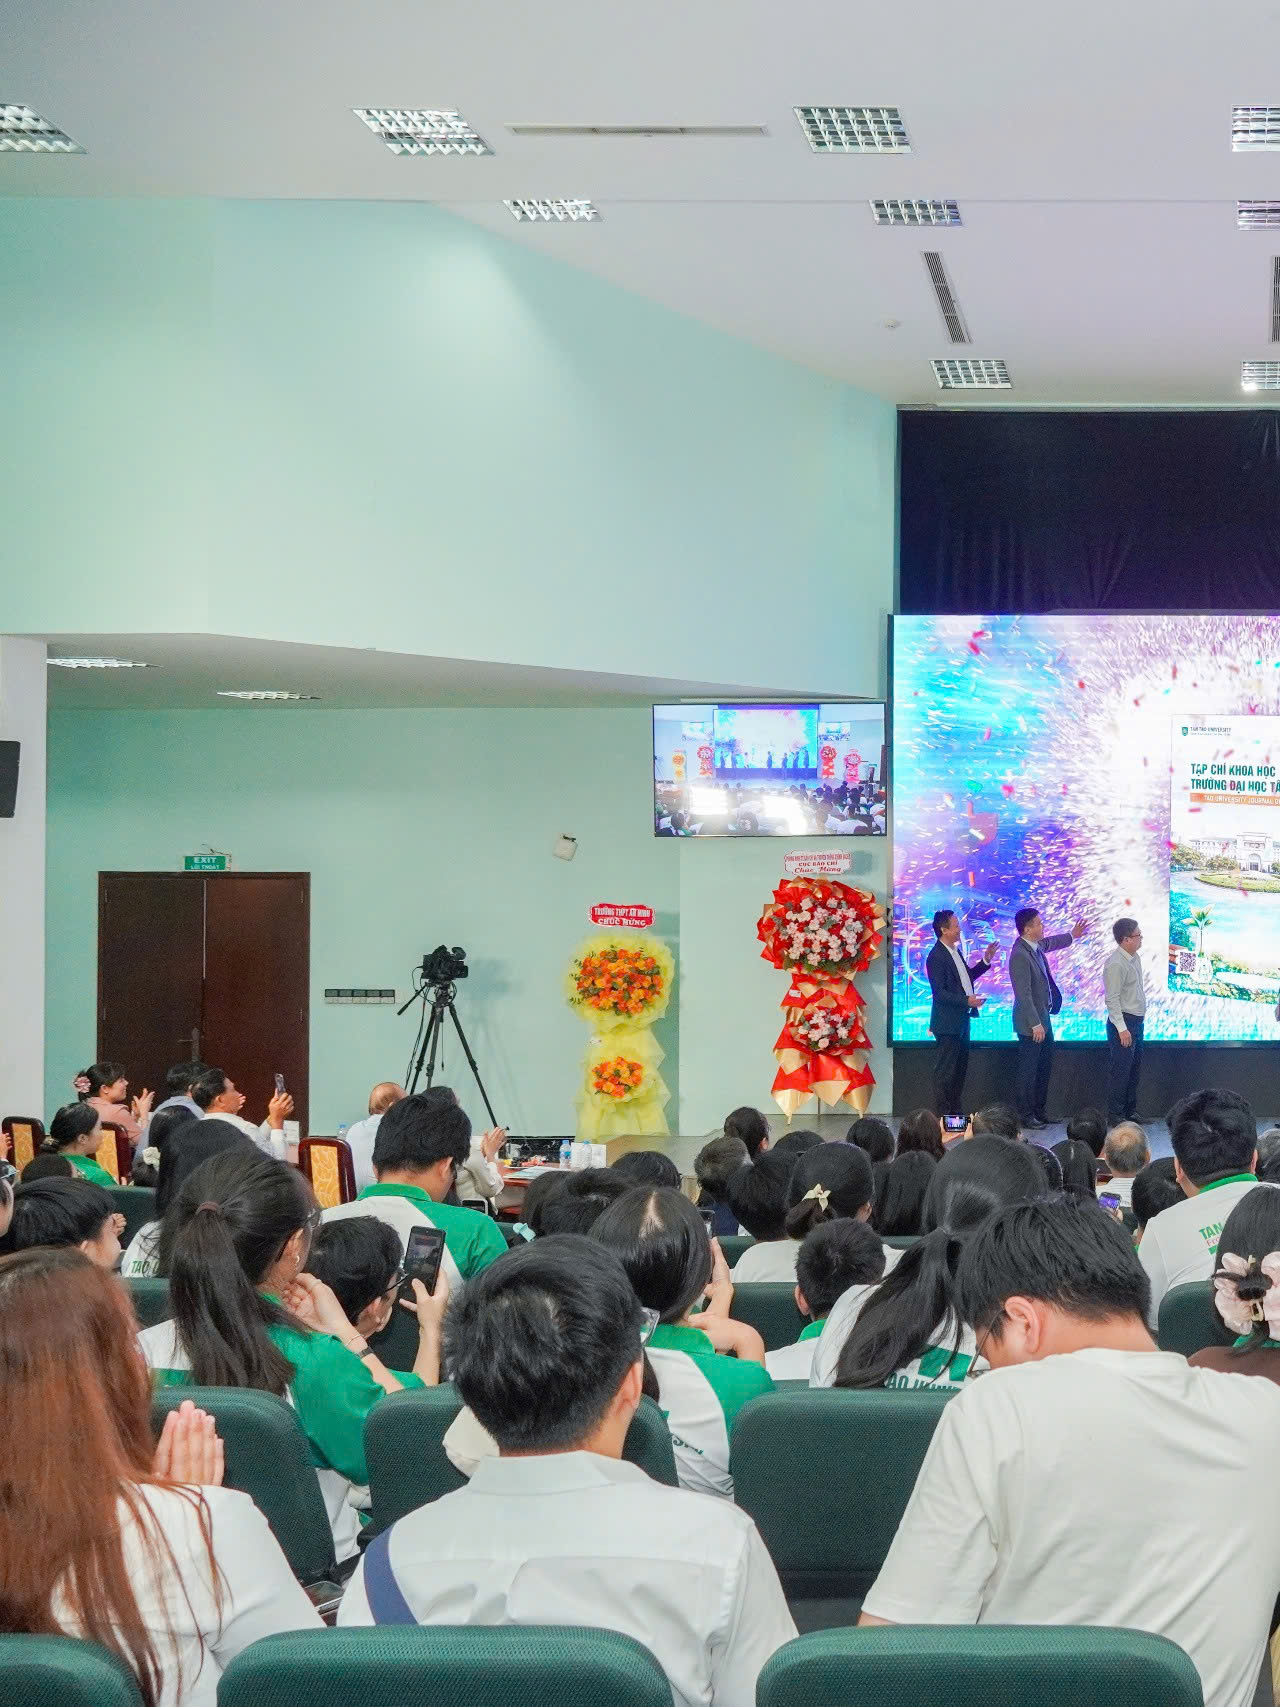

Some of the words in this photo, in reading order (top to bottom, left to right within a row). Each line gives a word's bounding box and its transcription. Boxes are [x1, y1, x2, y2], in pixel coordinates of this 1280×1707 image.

[1191, 763, 1207, 776] TẠP
[1211, 762, 1226, 775] CHÍ
[1229, 764, 1254, 776] KHOA
[1257, 765, 1276, 779] HỌC
[1191, 777, 1227, 791] TRƯỜNG
[1229, 780, 1245, 794] ĐẠI
[1248, 781, 1267, 794] HỌC
[1248, 797, 1273, 805] JOURNAL
[1199, 1222, 1223, 1240] TAN
